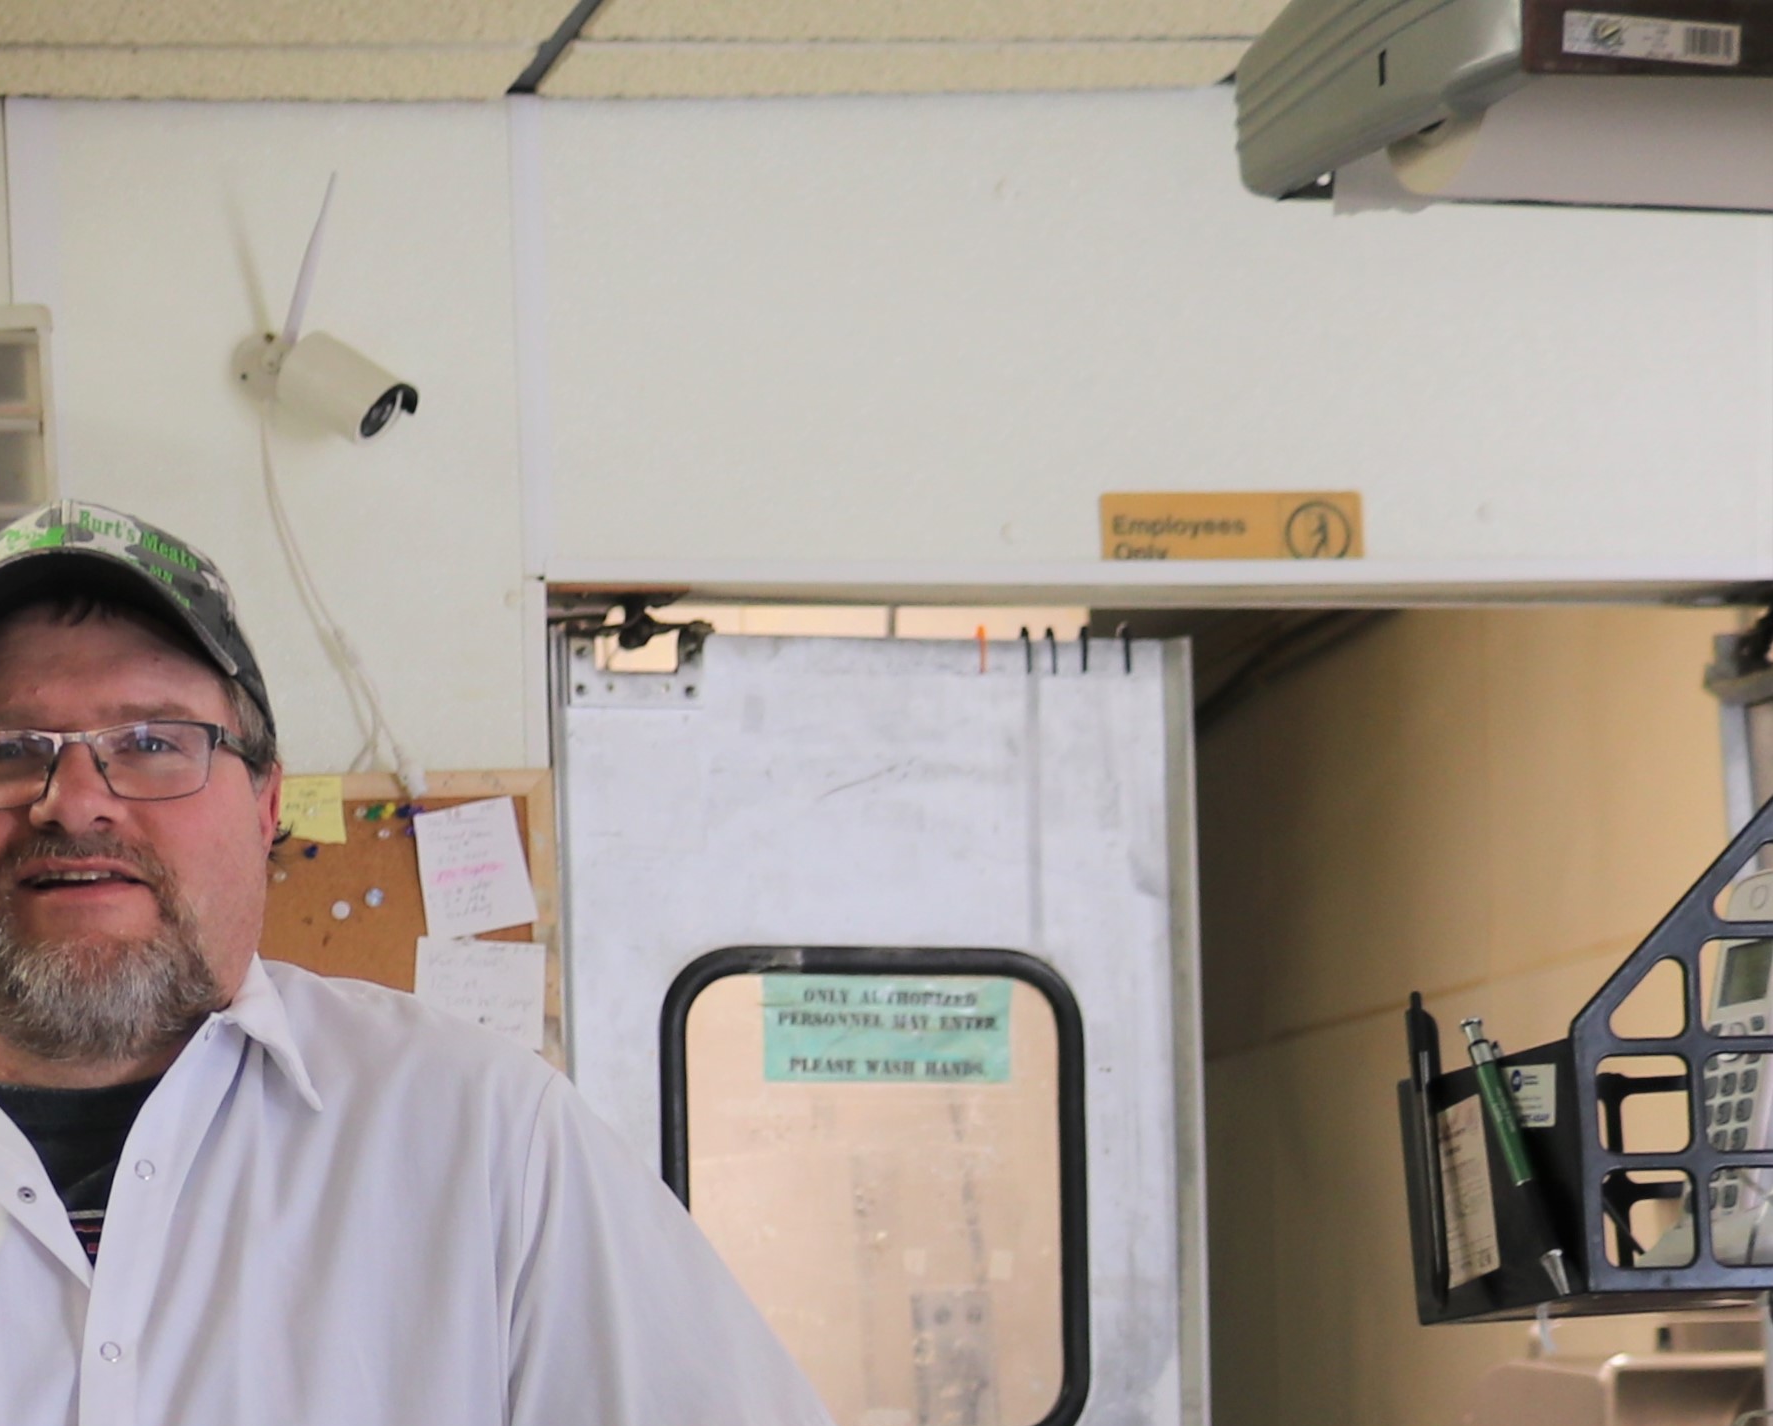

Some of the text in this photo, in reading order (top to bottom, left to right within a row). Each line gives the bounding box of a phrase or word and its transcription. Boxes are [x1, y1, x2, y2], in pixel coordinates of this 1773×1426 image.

[1112, 513, 1247, 538] Employees
[78, 509, 136, 544] Burt's
[141, 530, 198, 572] Meats
[1113, 542, 1170, 560] Only
[803, 988, 849, 1005] ONLY
[778, 1010, 998, 1031] PERSONNEL MAY ENTER
[788, 1057, 856, 1075] PLEASE
[865, 1058, 915, 1076] WASH
